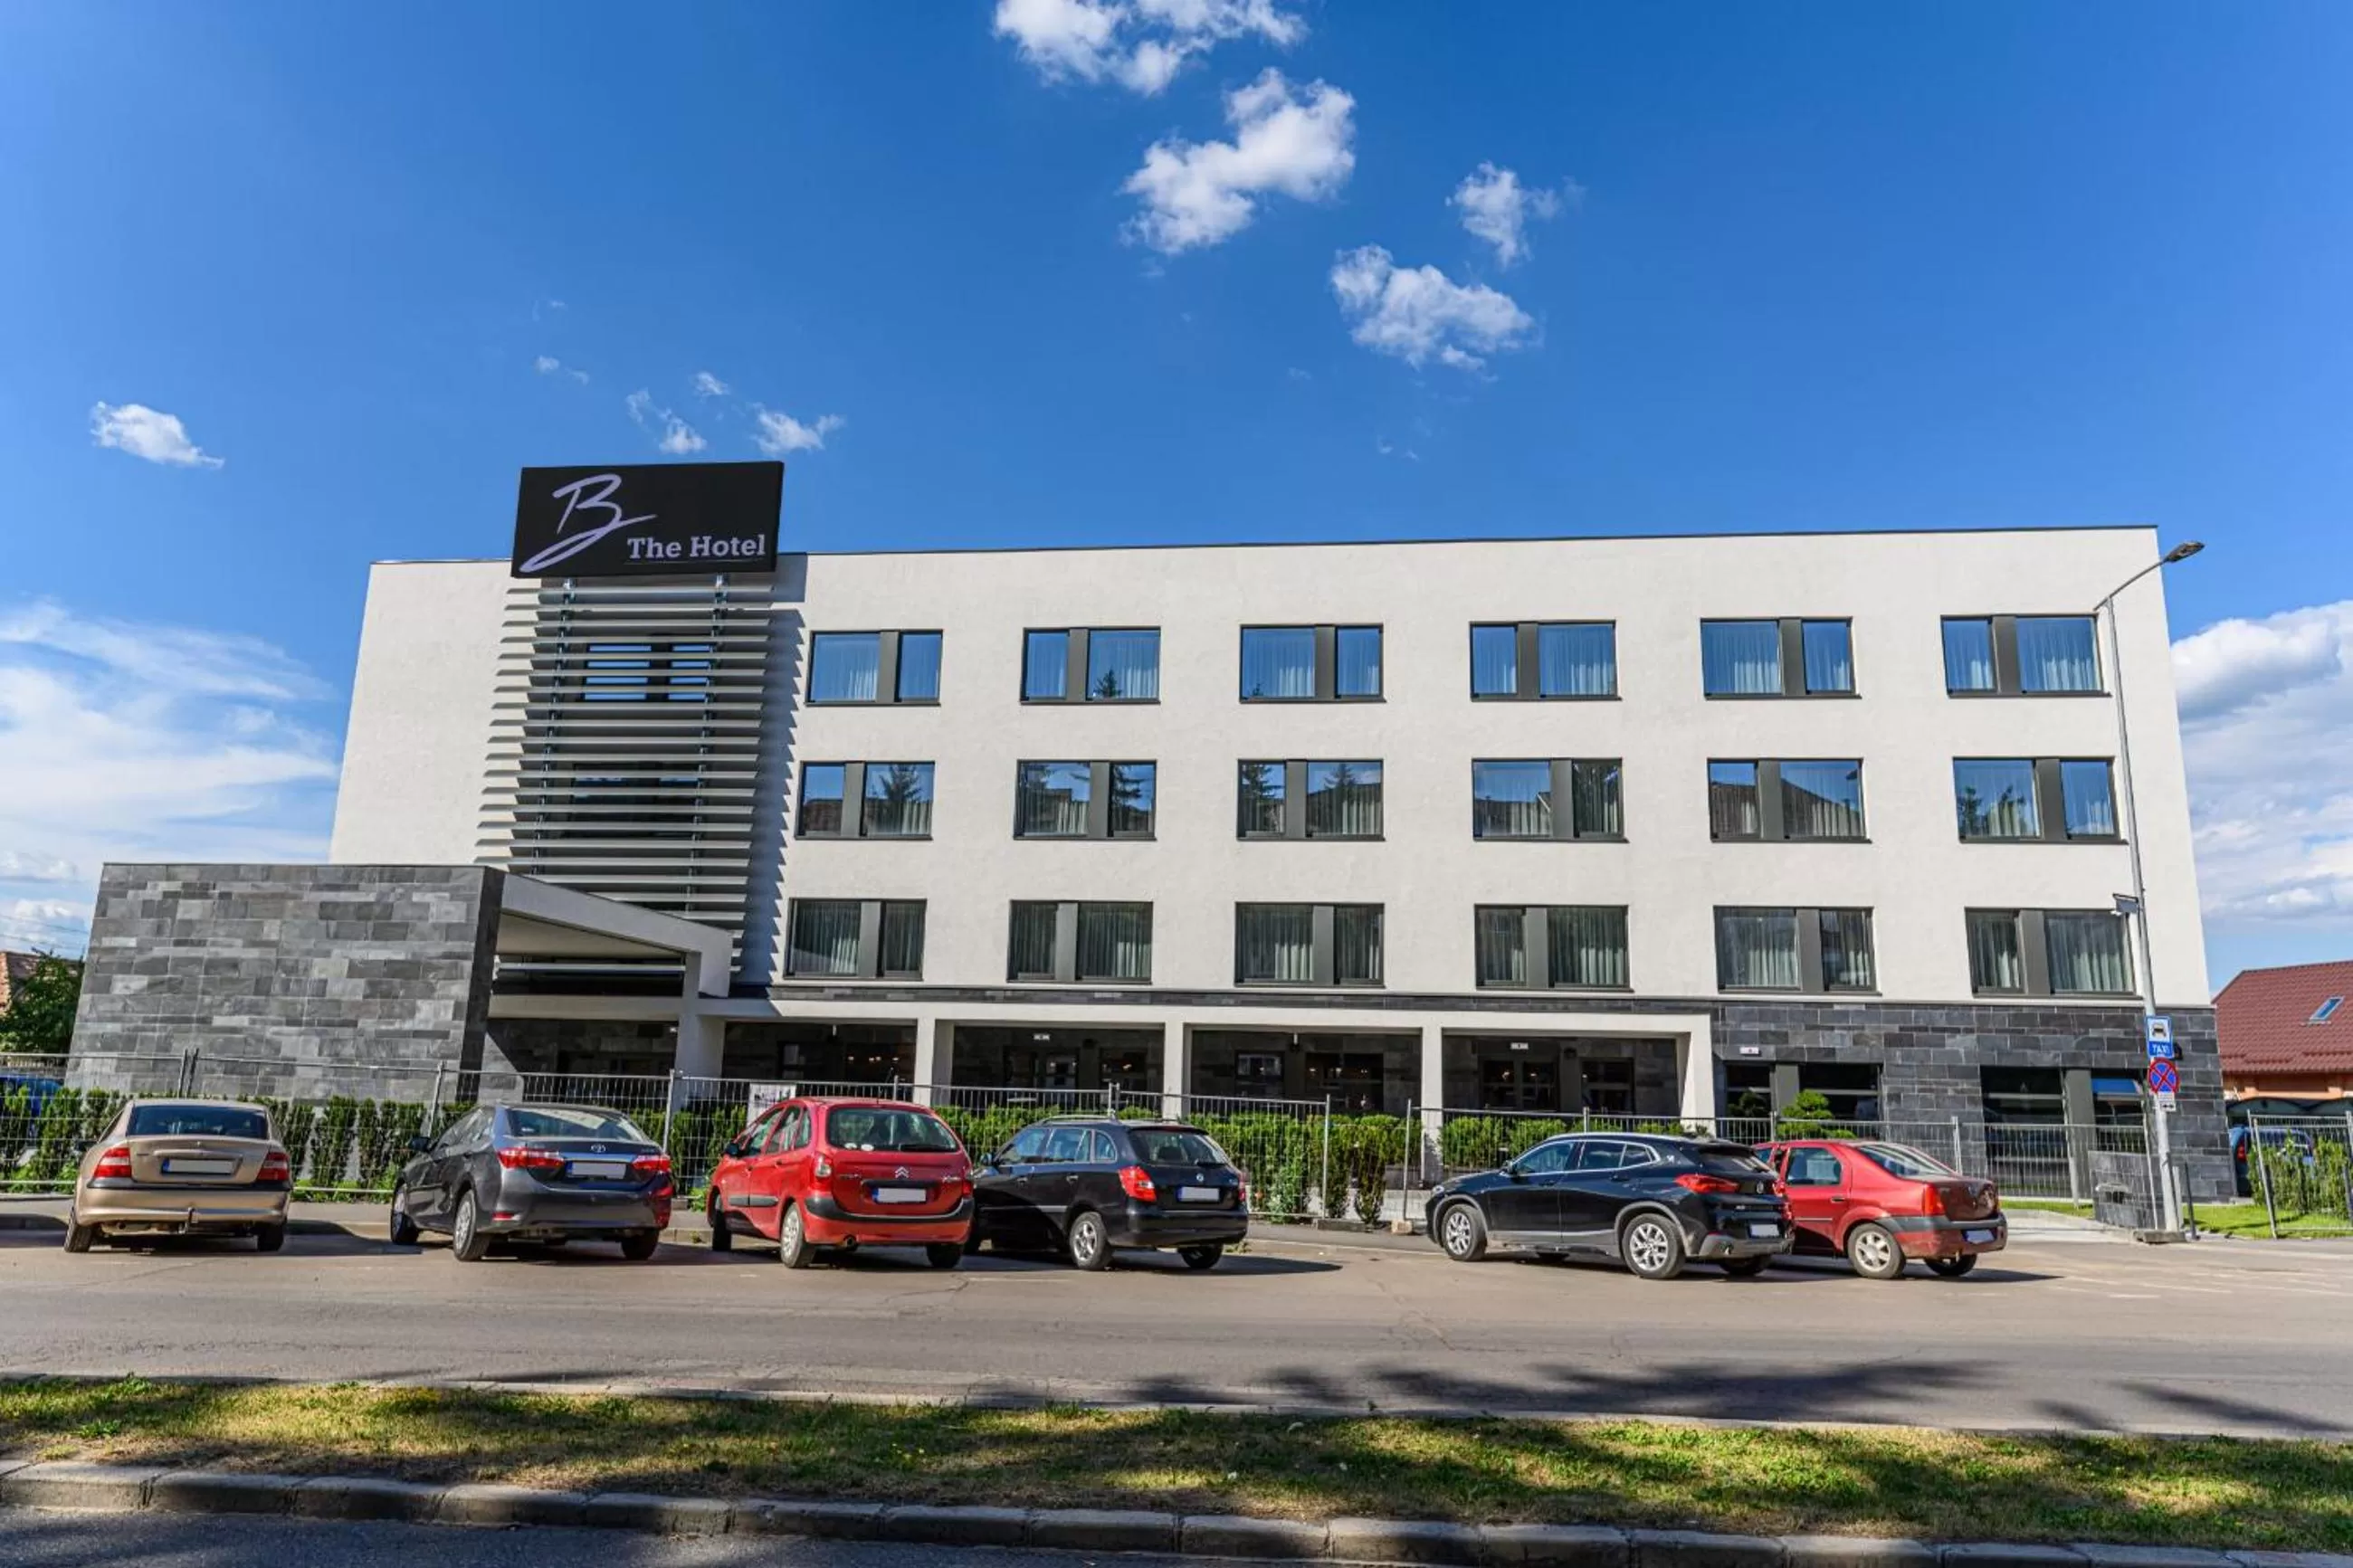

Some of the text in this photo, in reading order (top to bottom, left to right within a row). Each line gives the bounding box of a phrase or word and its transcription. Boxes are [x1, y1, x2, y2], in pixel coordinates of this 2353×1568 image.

[519, 473, 658, 573] B
[627, 534, 766, 559] The Hotel
